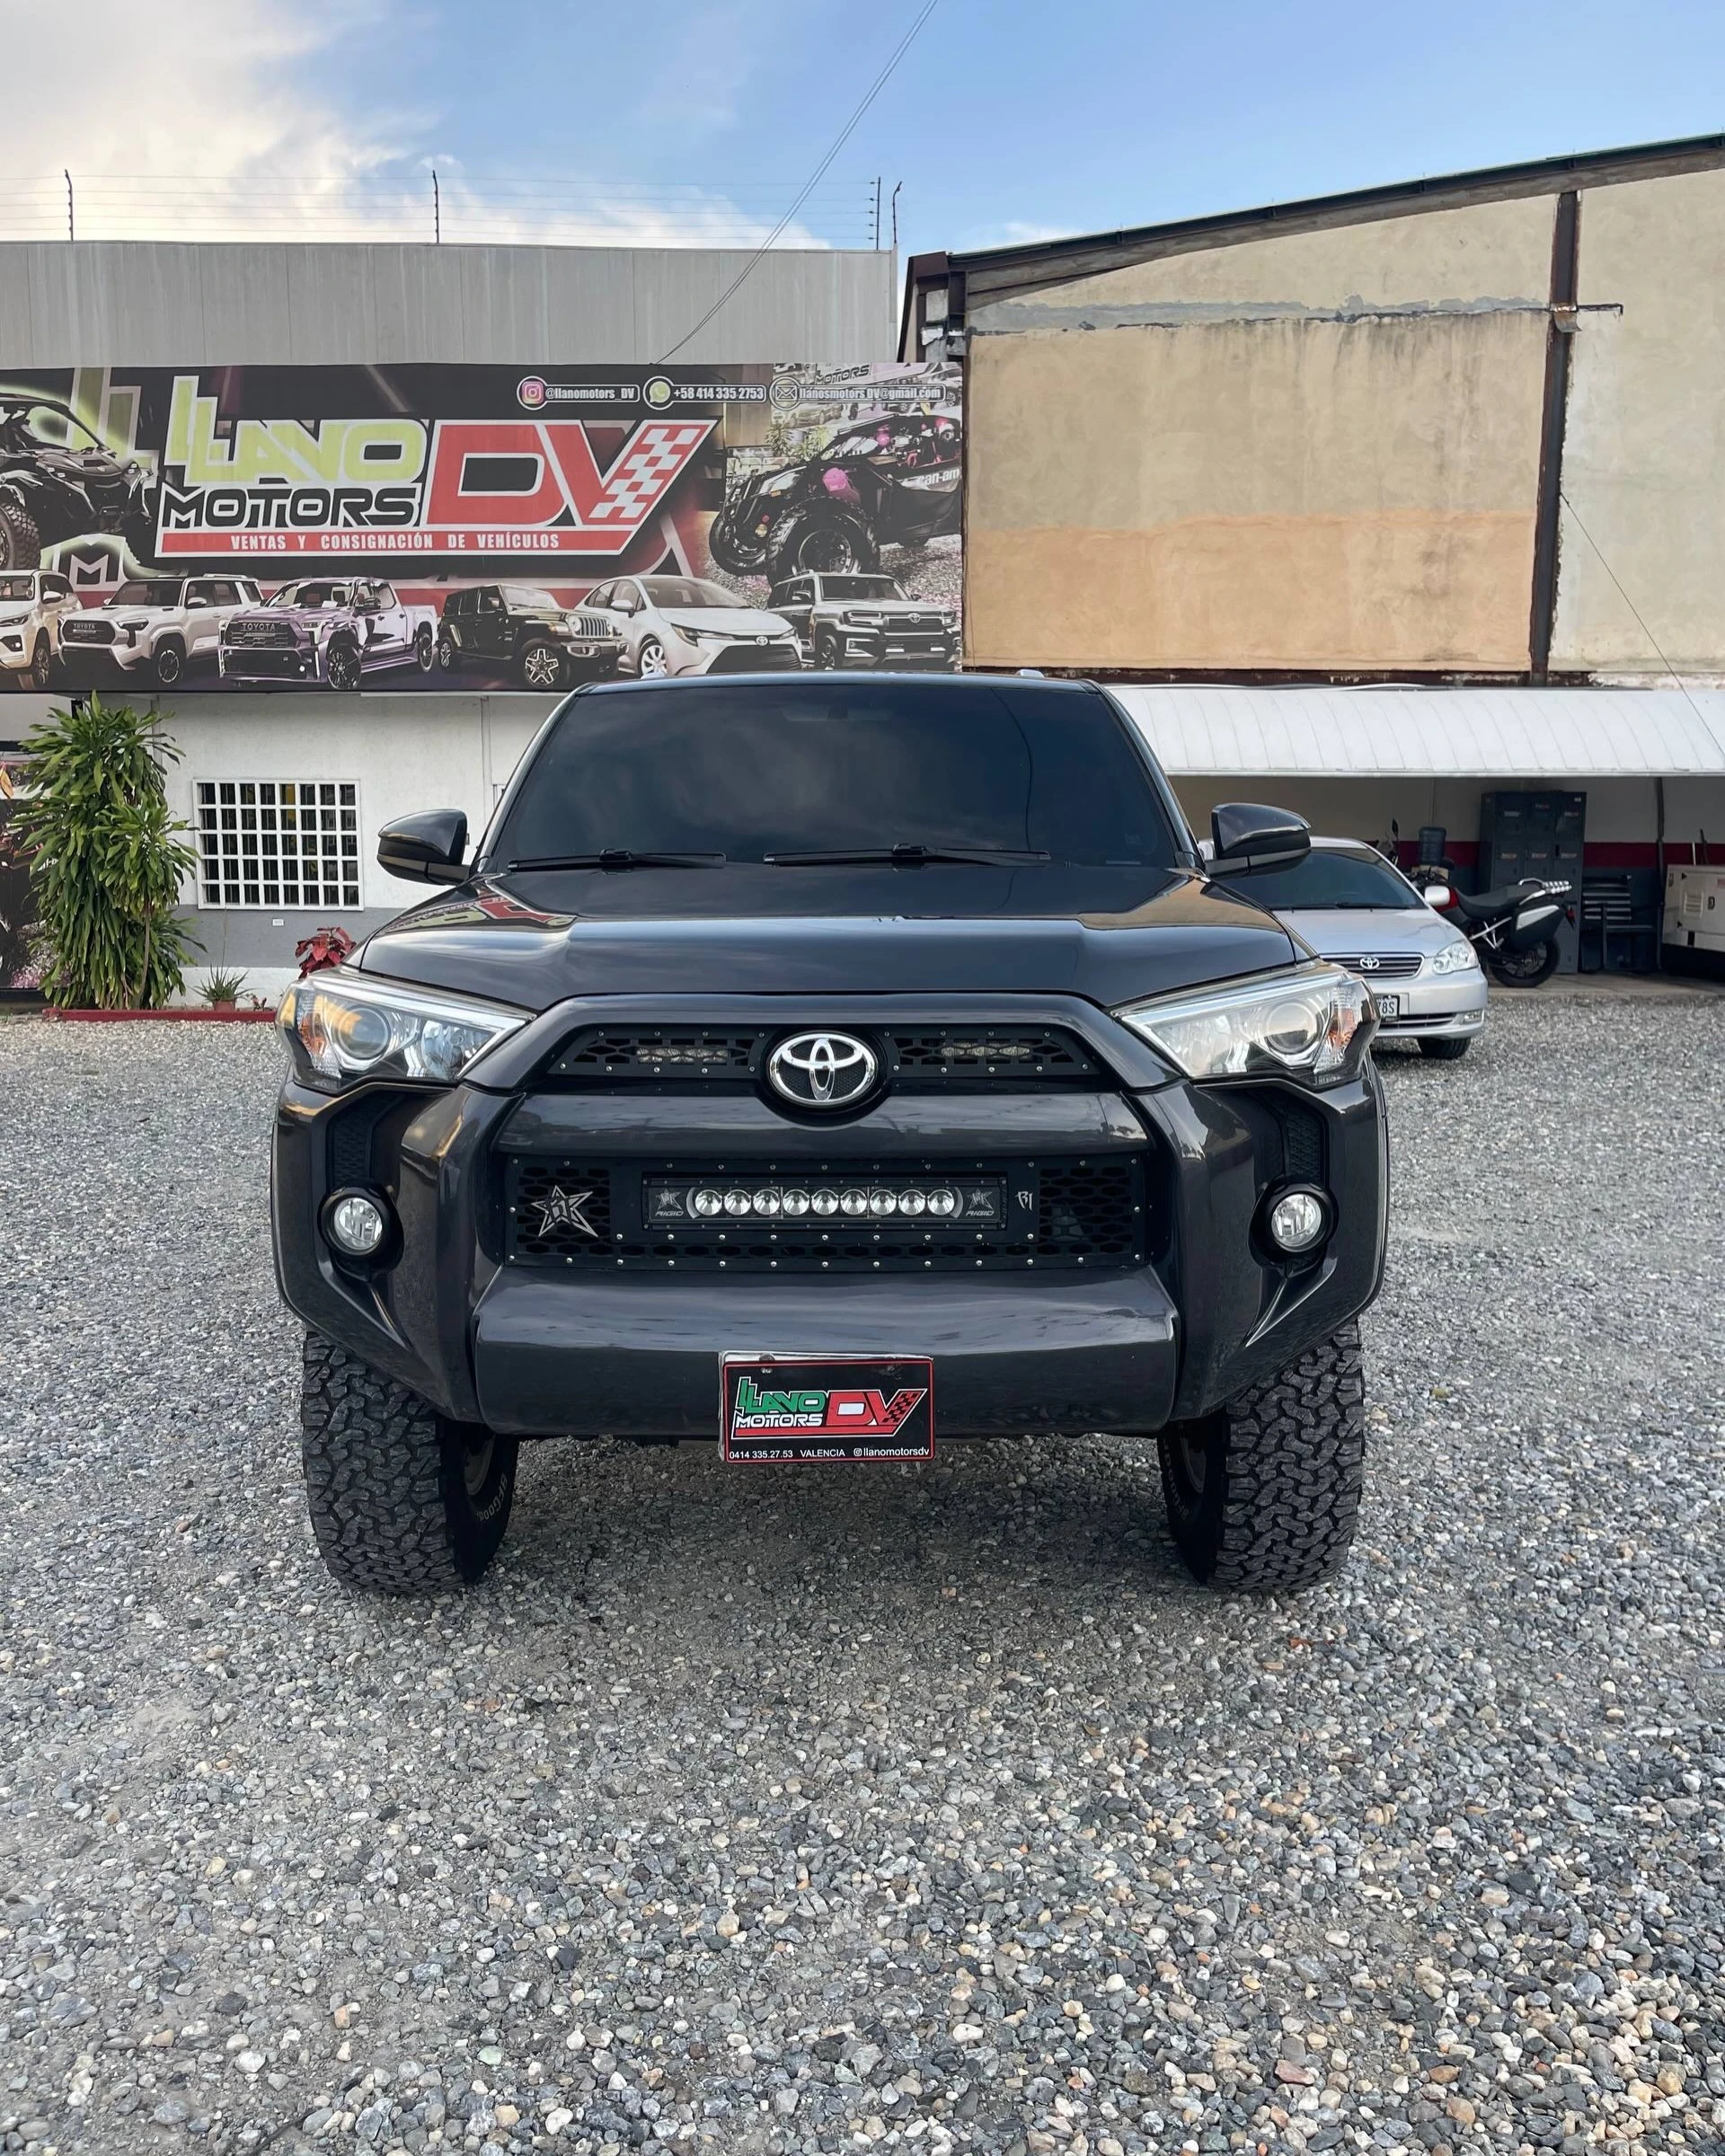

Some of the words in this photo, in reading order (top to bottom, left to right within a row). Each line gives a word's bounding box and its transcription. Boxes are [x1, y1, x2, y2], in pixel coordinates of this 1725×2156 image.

[816, 364, 870, 384] MOTORS
[545, 387, 634, 401] @llanomotors_DV
[674, 387, 694, 400] +58
[696, 387, 714, 400] 414
[715, 387, 736, 400] 335
[738, 387, 764, 400] 2753
[164, 376, 428, 486] LLANO
[427, 419, 718, 526] DV
[162, 486, 420, 528] MOTORS
[231, 535, 286, 550] VENTAS
[297, 535, 306, 549] Y
[321, 532, 432, 550] CONSIGNACIÓN
[447, 534, 465, 549] DE
[477, 532, 559, 549] VEHÍCULOS
[242, 623, 275, 631] TOYOTA
[737, 1376, 827, 1414] LLANO
[825, 1389, 927, 1427] DV
[735, 1413, 824, 1428] MOTORS
[729, 1450, 750, 1460] 0414
[752, 1449, 793, 1459] 335.27.53
[800, 1448, 845, 1458] VALENCIA
